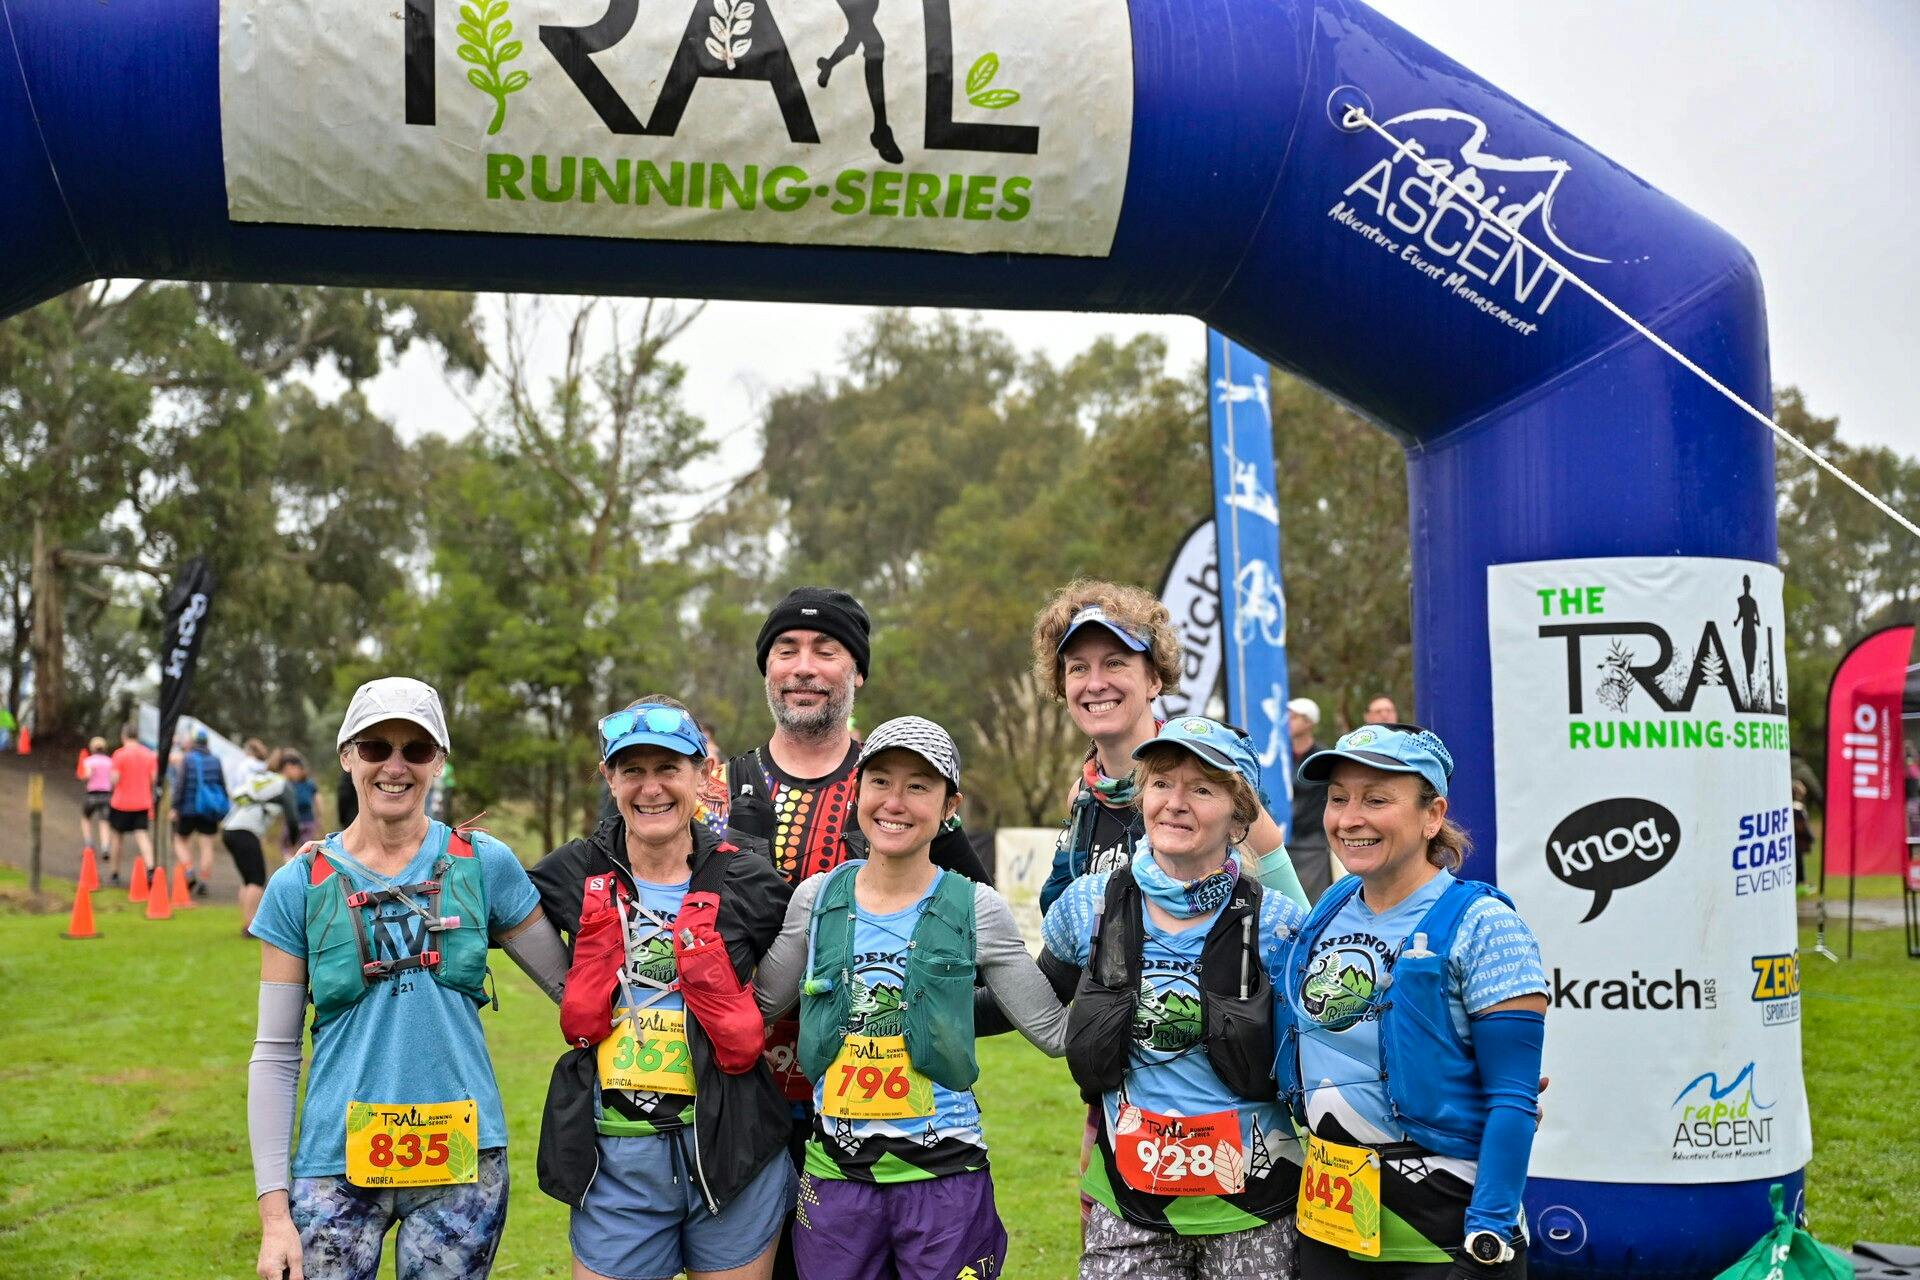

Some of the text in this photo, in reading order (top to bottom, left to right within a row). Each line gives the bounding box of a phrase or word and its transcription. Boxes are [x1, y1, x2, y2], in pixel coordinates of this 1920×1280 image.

[1392, 138, 1546, 232] rapid
[1343, 158, 1566, 315] ASCENT
[1328, 201, 1538, 335] Adventure Event Management
[1537, 587, 1606, 616] THE
[1538, 575, 1788, 716] TRAIL
[1738, 807, 1790, 841] SURF
[1732, 834, 1793, 871] COAST
[1735, 863, 1793, 897] EVENTS
[1703, 978, 1717, 1010] LABS
[1765, 1002, 1790, 1021] SPORTS
[612, 1036, 689, 1075] 362
[849, 1039, 885, 1060] TRAIL
[606, 1078, 632, 1087] PATRICIA
[836, 1064, 911, 1100] 796
[381, 1106, 427, 1127] TRAIL
[1683, 1090, 1750, 1128] rapid
[1146, 1118, 1189, 1139] TRAIL
[1673, 1117, 1773, 1148] ASCENT
[369, 1133, 450, 1168] 835
[1136, 1140, 1215, 1177] 928
[366, 1176, 394, 1184] ANDREA
[1304, 1164, 1354, 1215] 842
[976, 1254, 995, 1278] T8
